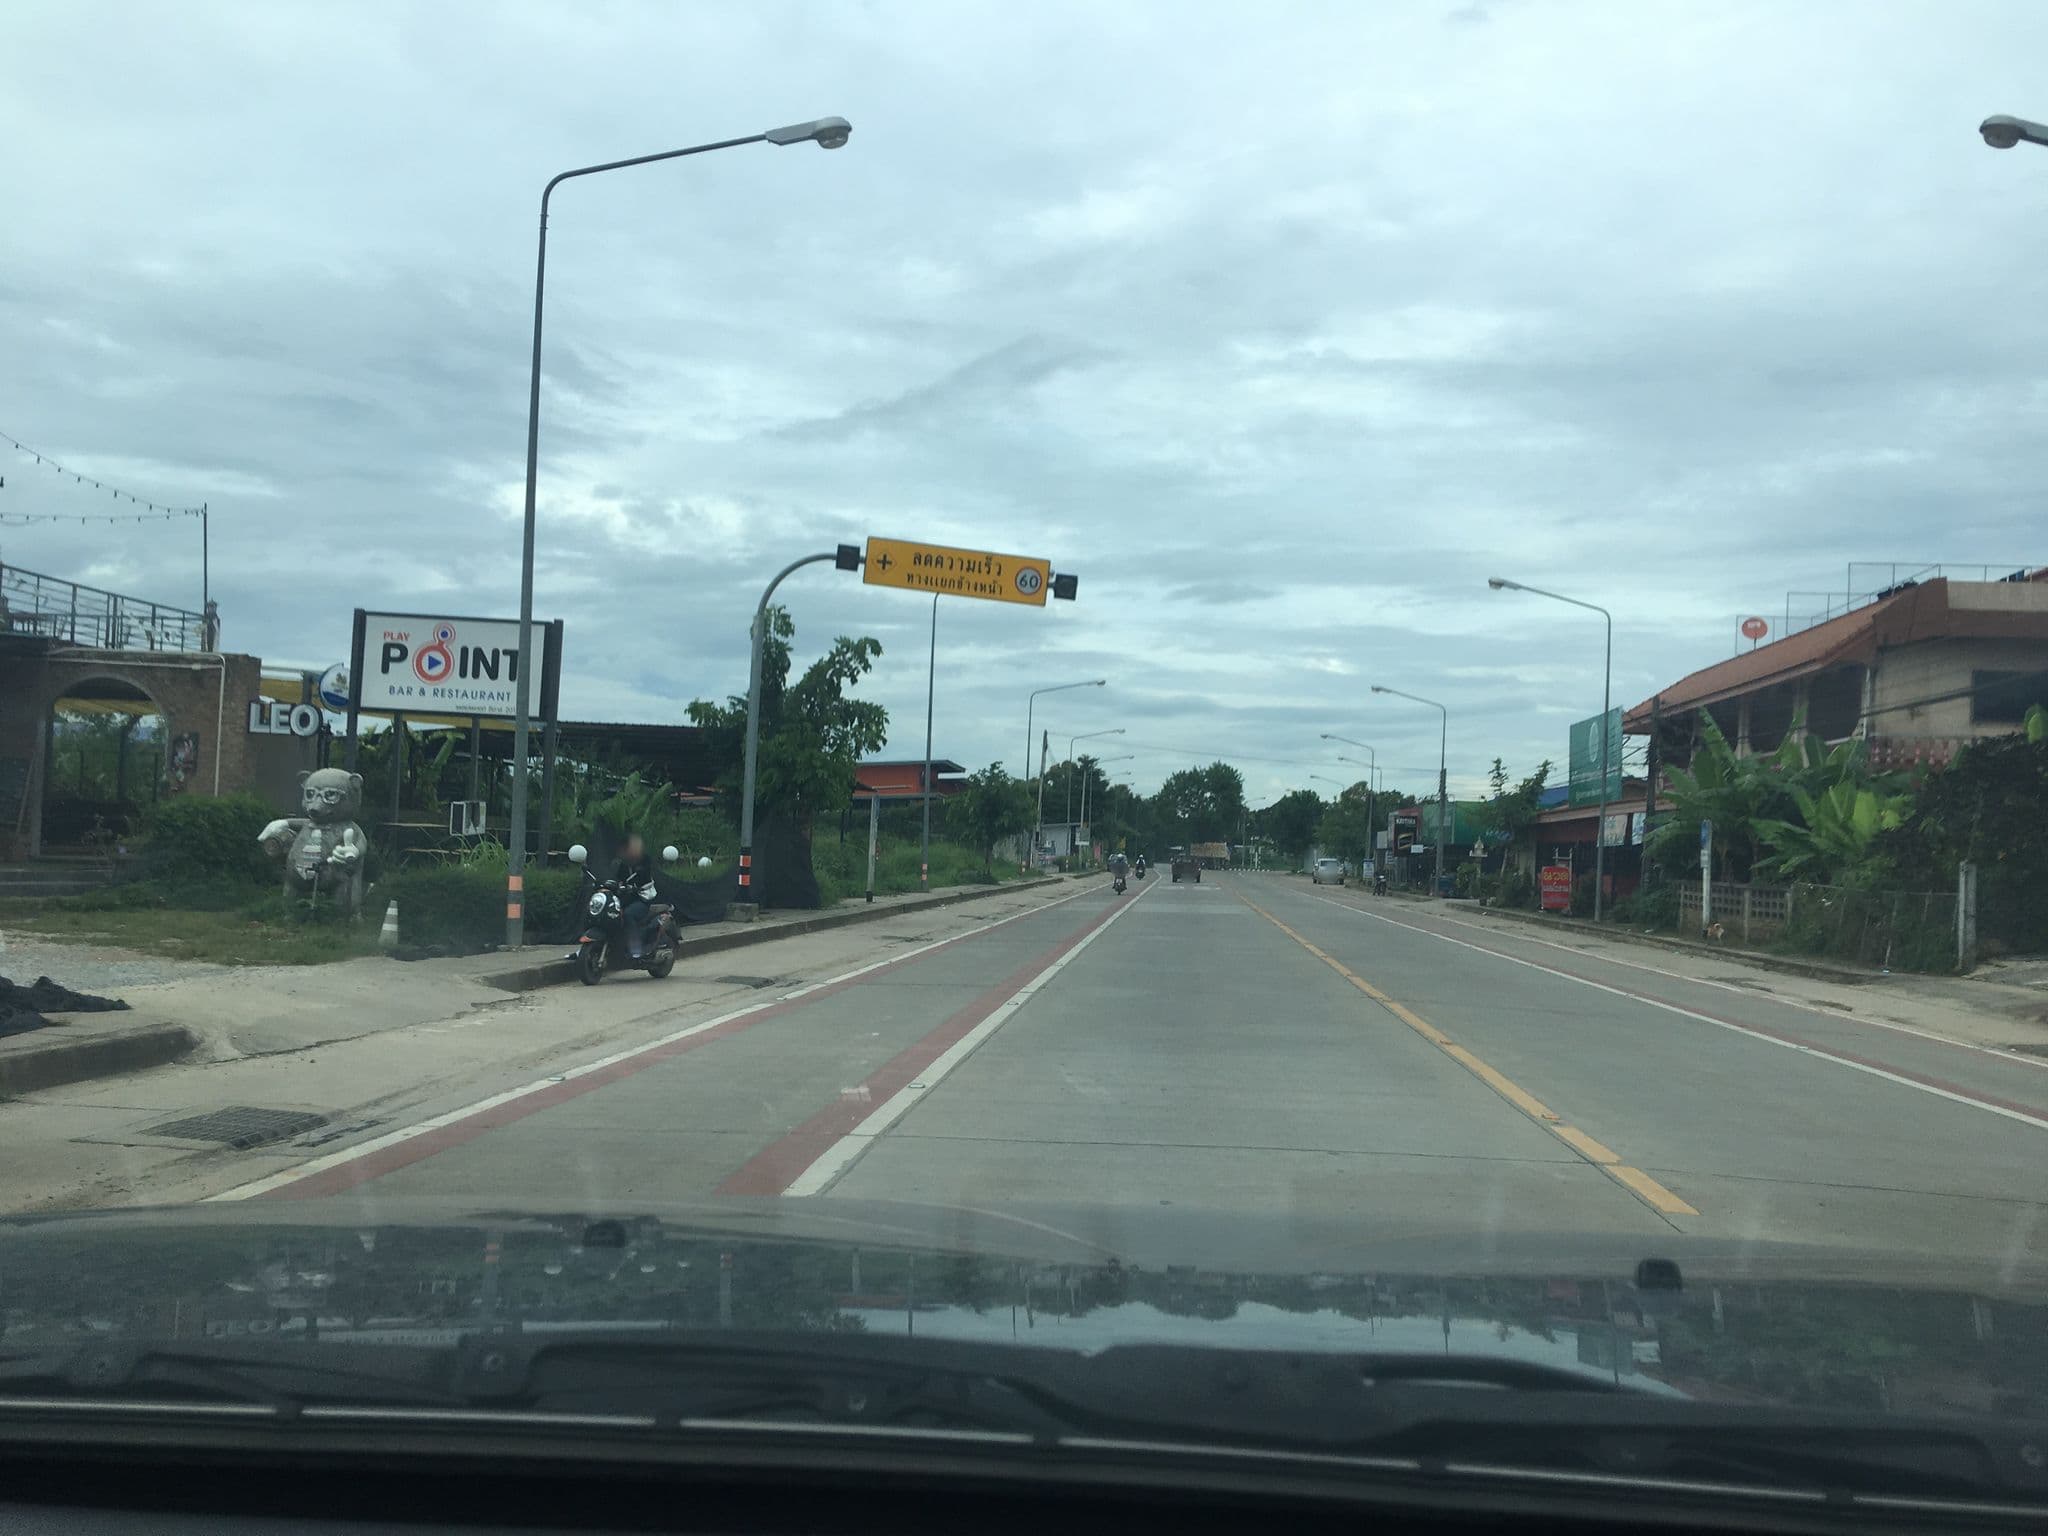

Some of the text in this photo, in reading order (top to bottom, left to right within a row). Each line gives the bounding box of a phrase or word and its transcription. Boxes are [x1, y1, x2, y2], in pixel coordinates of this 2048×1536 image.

[913, 552, 1002, 576] ลดความเร็ว
[1019, 573, 1039, 588] 60
[383, 631, 410, 641] PLAY
[381, 641, 520, 684] POINT
[388, 685, 512, 701] BAR & RESTAURANT
[248, 702, 321, 737] LEO
